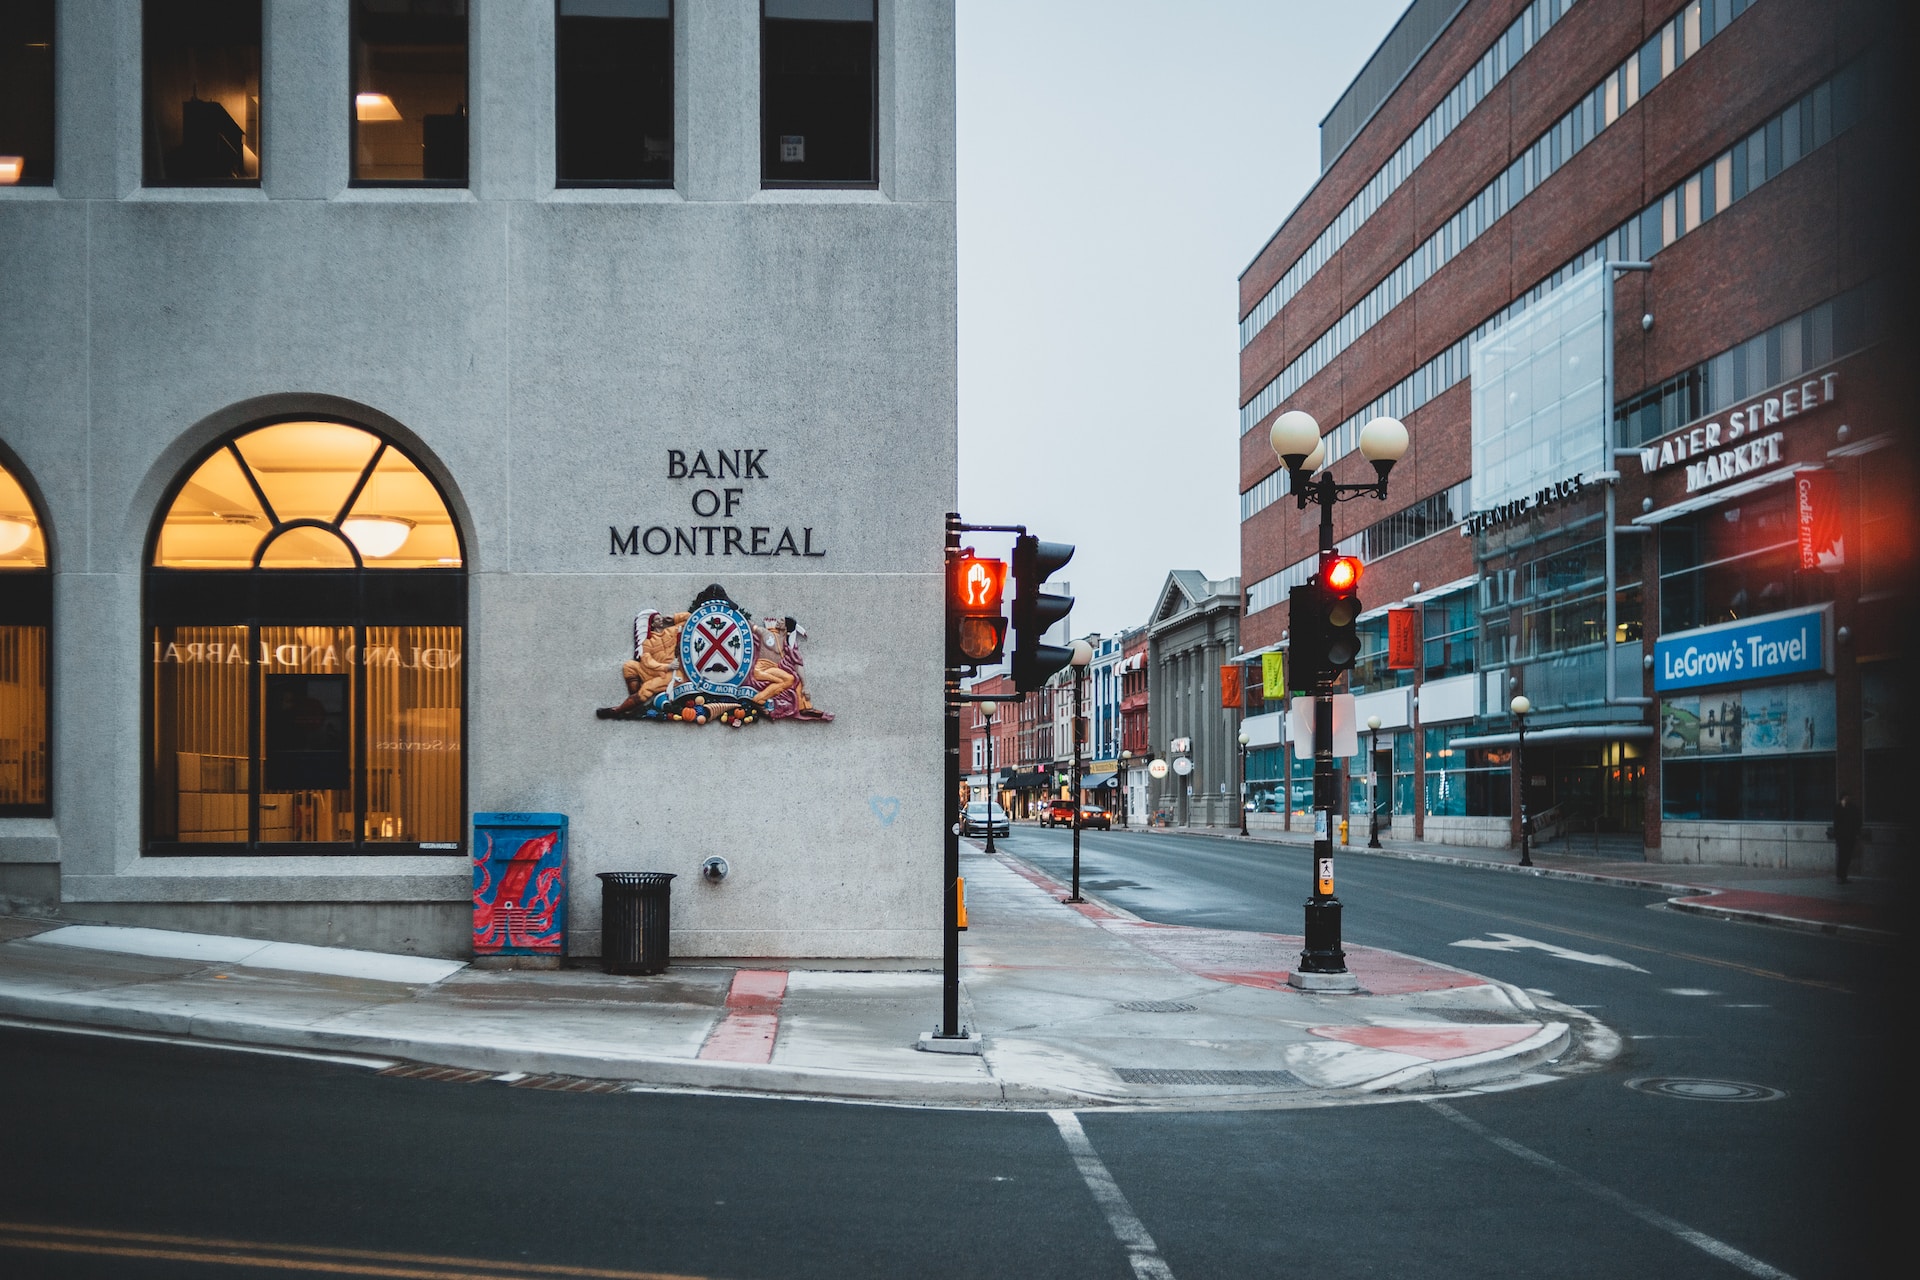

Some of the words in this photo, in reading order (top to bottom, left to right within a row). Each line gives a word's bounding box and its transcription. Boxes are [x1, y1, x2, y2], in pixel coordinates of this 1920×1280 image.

[1640, 419, 1721, 473] WATER
[1729, 373, 1838, 440] STREET
[667, 449, 769, 479] BANK
[1686, 431, 1784, 494] MARKET
[691, 488, 743, 517] OF
[1534, 473, 1583, 506] PLACE
[609, 526, 826, 557] MONTREAL
[1800, 526, 1814, 569] FITNESS
[683, 605, 734, 665] CONCORDIA
[738, 620, 752, 664] SALUS
[1664, 638, 1744, 681] LeGrow's
[1747, 627, 1807, 669] Travel
[674, 684, 694, 696] BANK
[703, 682, 713, 692] OF
[715, 685, 757, 698] MONTREAL
